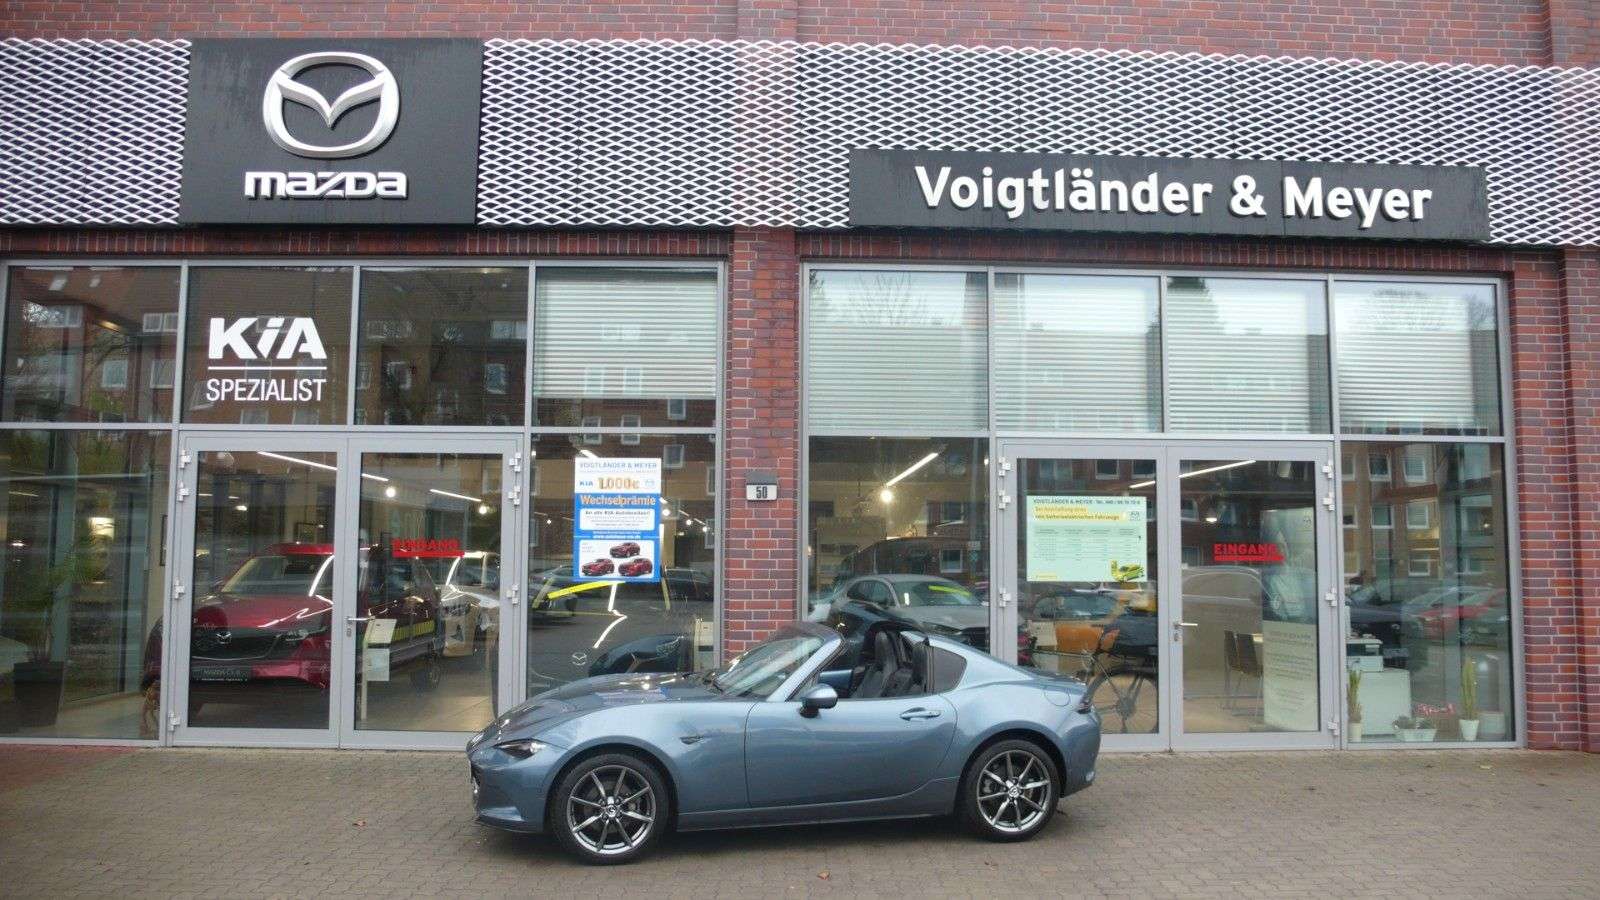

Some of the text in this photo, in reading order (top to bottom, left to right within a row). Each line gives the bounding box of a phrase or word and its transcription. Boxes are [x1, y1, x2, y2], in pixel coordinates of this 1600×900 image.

[914, 165, 1433, 229] Voigtländer & Meyer
[208, 317, 328, 360] KIA
[206, 378, 327, 401] SPEZIALIST
[580, 461, 626, 469] VOIGTLÄNDER
[756, 485, 768, 499] 50
[580, 494, 656, 507] Wechselprämie
[1214, 543, 1278, 555] EINGANG
